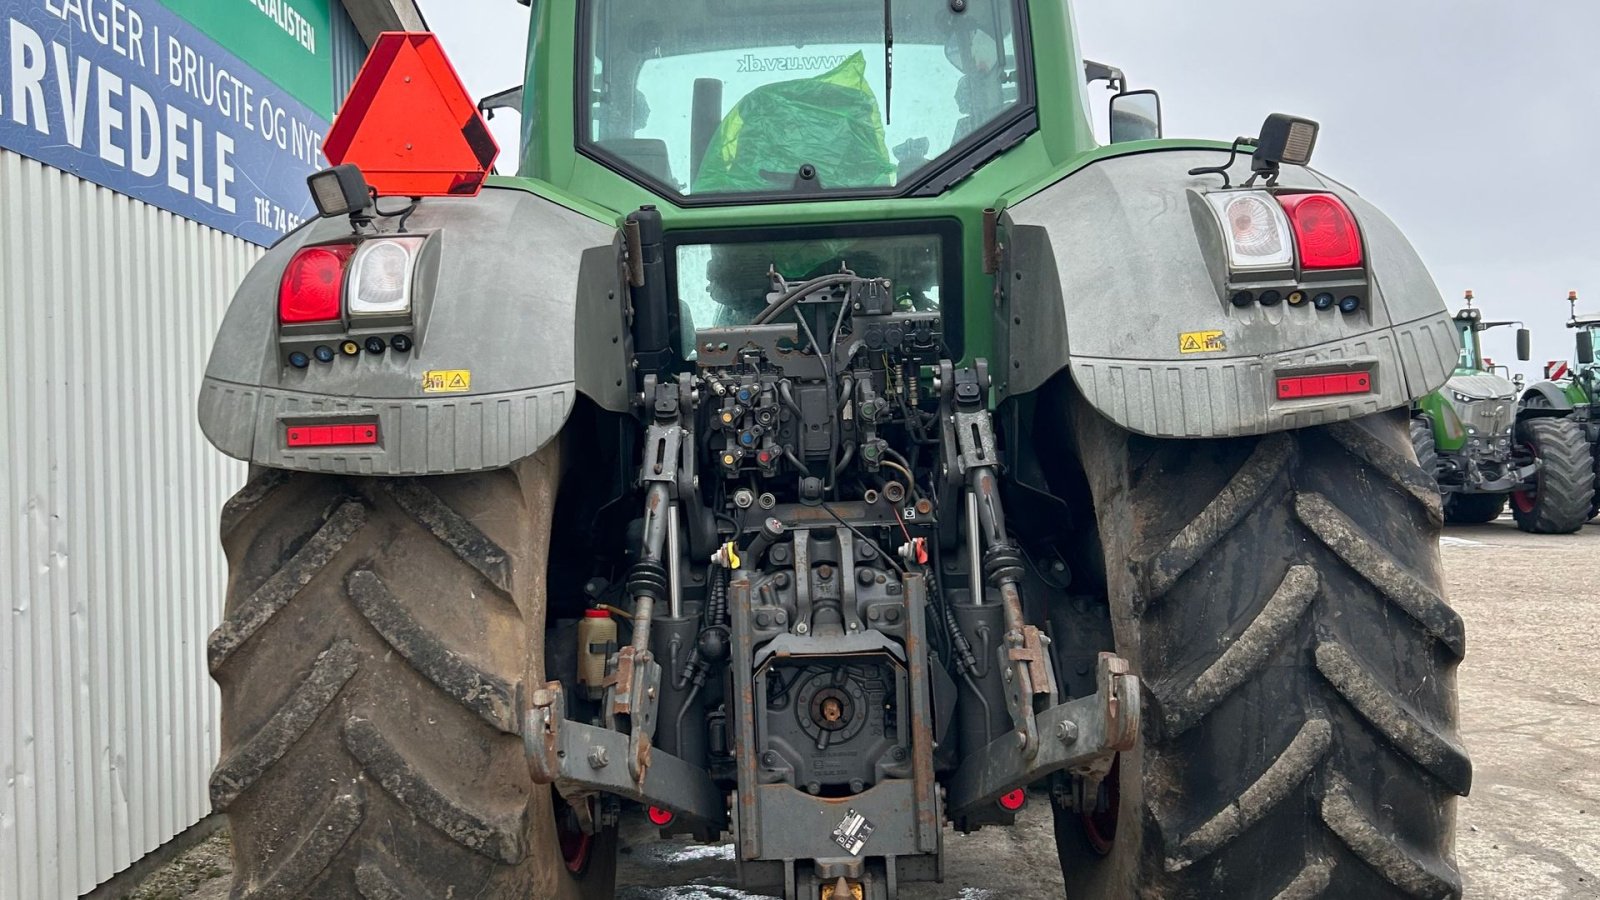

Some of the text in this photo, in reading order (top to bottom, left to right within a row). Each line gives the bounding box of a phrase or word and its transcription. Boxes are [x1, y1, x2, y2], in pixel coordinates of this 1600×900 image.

[250, 0, 315, 54] IALISTEN
[0, 17, 236, 213] RVEDELE
[45, 0, 321, 171] AGER I BRUGTE OG NYE
[254, 197, 273, 228] Tlf.
[273, 205, 287, 234] 74
